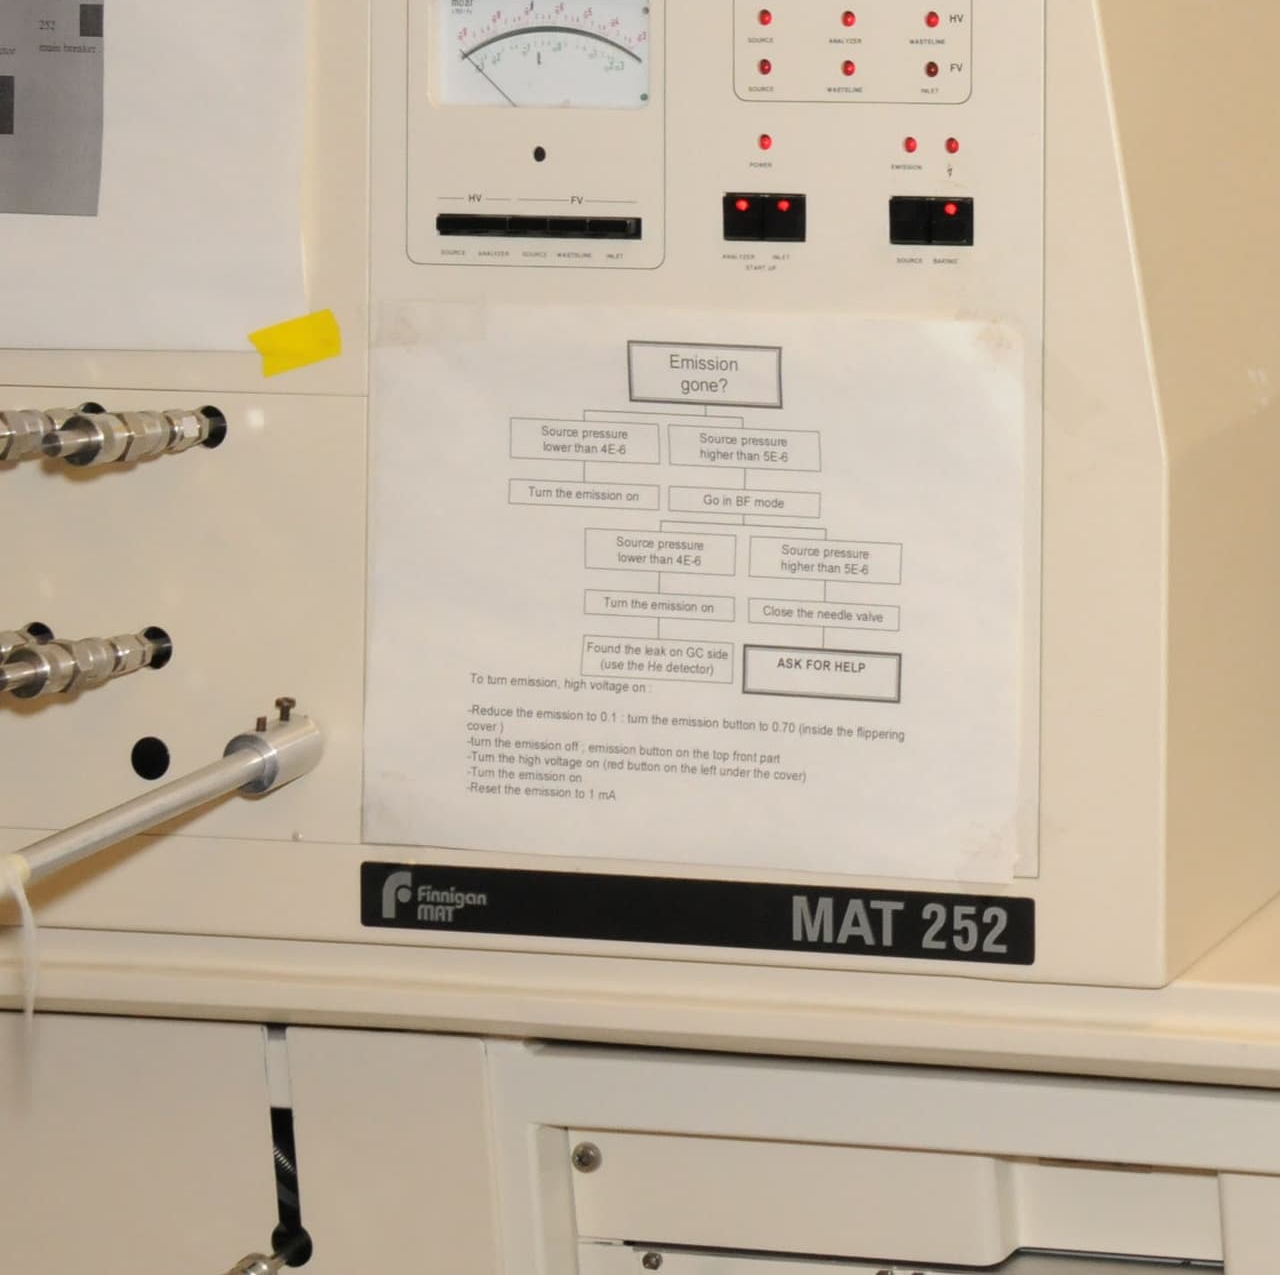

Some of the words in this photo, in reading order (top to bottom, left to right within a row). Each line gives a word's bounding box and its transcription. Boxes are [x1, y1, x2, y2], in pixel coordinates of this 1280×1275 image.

[949, 14, 964, 23] HV
[950, 63, 963, 72] FV
[468, 194, 482, 202] HV
[570, 196, 584, 205] FV
[669, 354, 738, 372] Emission
[681, 377, 728, 395] gone?
[541, 425, 578, 438] Source
[582, 428, 628, 442] pressure
[699, 433, 737, 446] Source
[741, 436, 788, 450] pressure
[542, 441, 572, 454] lower
[574, 443, 598, 455] than
[600, 444, 626, 455] 4E-6
[700, 449, 734, 463] higher
[736, 450, 760, 462] than
[763, 451, 788, 463] 5E-6
[528, 486, 553, 498] Turn
[555, 487, 572, 499] the
[575, 489, 622, 501] emission
[626, 492, 640, 502] on
[703, 494, 720, 506] Go
[722, 495, 733, 506] in
[735, 496, 751, 507] BF
[754, 497, 785, 509] mode
[616, 536, 654, 549] Source
[658, 539, 704, 552] pressure
[781, 544, 820, 557] Source
[823, 547, 870, 561] pressure
[617, 552, 647, 565] lower
[649, 554, 673, 565] than
[676, 555, 702, 567] 4E-6
[780, 560, 815, 574] higher
[817, 562, 841, 574] than
[844, 563, 869, 576] 5E-6
[604, 596, 628, 609] Turn
[631, 598, 648, 610] the
[650, 599, 697, 612] emission
[700, 603, 714, 613] on
[763, 605, 794, 618] Close
[797, 607, 814, 619] the
[817, 608, 853, 621] needle
[855, 611, 884, 623] valve
[586, 642, 621, 655] Found
[624, 643, 641, 655] the
[644, 644, 666, 657] leak
[669, 648, 683, 658] on
[686, 646, 704, 659] GC
[706, 647, 729, 660] side
[600, 659, 624, 672] (use
[627, 660, 645, 672] the
[647, 661, 663, 673] He
[665, 662, 714, 676] detector)
[776, 657, 802, 670] ASK
[806, 659, 831, 672] FOR
[834, 660, 866, 674] HELP
[470, 673, 484, 684] To
[487, 674, 507, 686] turn
[564, 678, 586, 692] high
[590, 679, 629, 694] voltage
[632, 684, 646, 693] on
[516, 707, 533, 718] the
[536, 708, 584, 721] emission
[586, 711, 597, 722] to
[627, 713, 648, 724] turn
[651, 714, 669, 725] the
[672, 715, 719, 729] emission
[723, 718, 756, 731] button
[759, 721, 769, 732] to
[772, 722, 795, 734] 0.70
[837, 725, 853, 737] the
[857, 726, 905, 742] flippering
[494, 737, 511, 749] the
[514, 739, 562, 751] emission
[565, 740, 579, 752] off
[588, 742, 636, 755] emission
[639, 745, 672, 757] button
[676, 748, 689, 758] on
[692, 748, 709, 760] the
[713, 750, 730, 763] top
[732, 750, 757, 763] front
[760, 753, 781, 765] part
[498, 753, 515, 764] the
[518, 753, 541, 767] high
[544, 755, 583, 770] voltage
[586, 759, 599, 768] on
[627, 760, 660, 773] button
[664, 764, 677, 774] on
[680, 763, 697, 775] the
[700, 764, 716, 776] left
[719, 765, 750, 778] under
[753, 768, 770, 780] the
[498, 768, 515, 779] the
[518, 769, 566, 782] emission
[569, 773, 582, 783] on
[504, 783, 521, 795] the
[524, 785, 572, 798] emission
[575, 787, 585, 798] to
[416, 886, 488, 910] Finnigan
[416, 903, 455, 922] MAT
[791, 895, 905, 948] MAT
[921, 902, 1008, 955] 252
